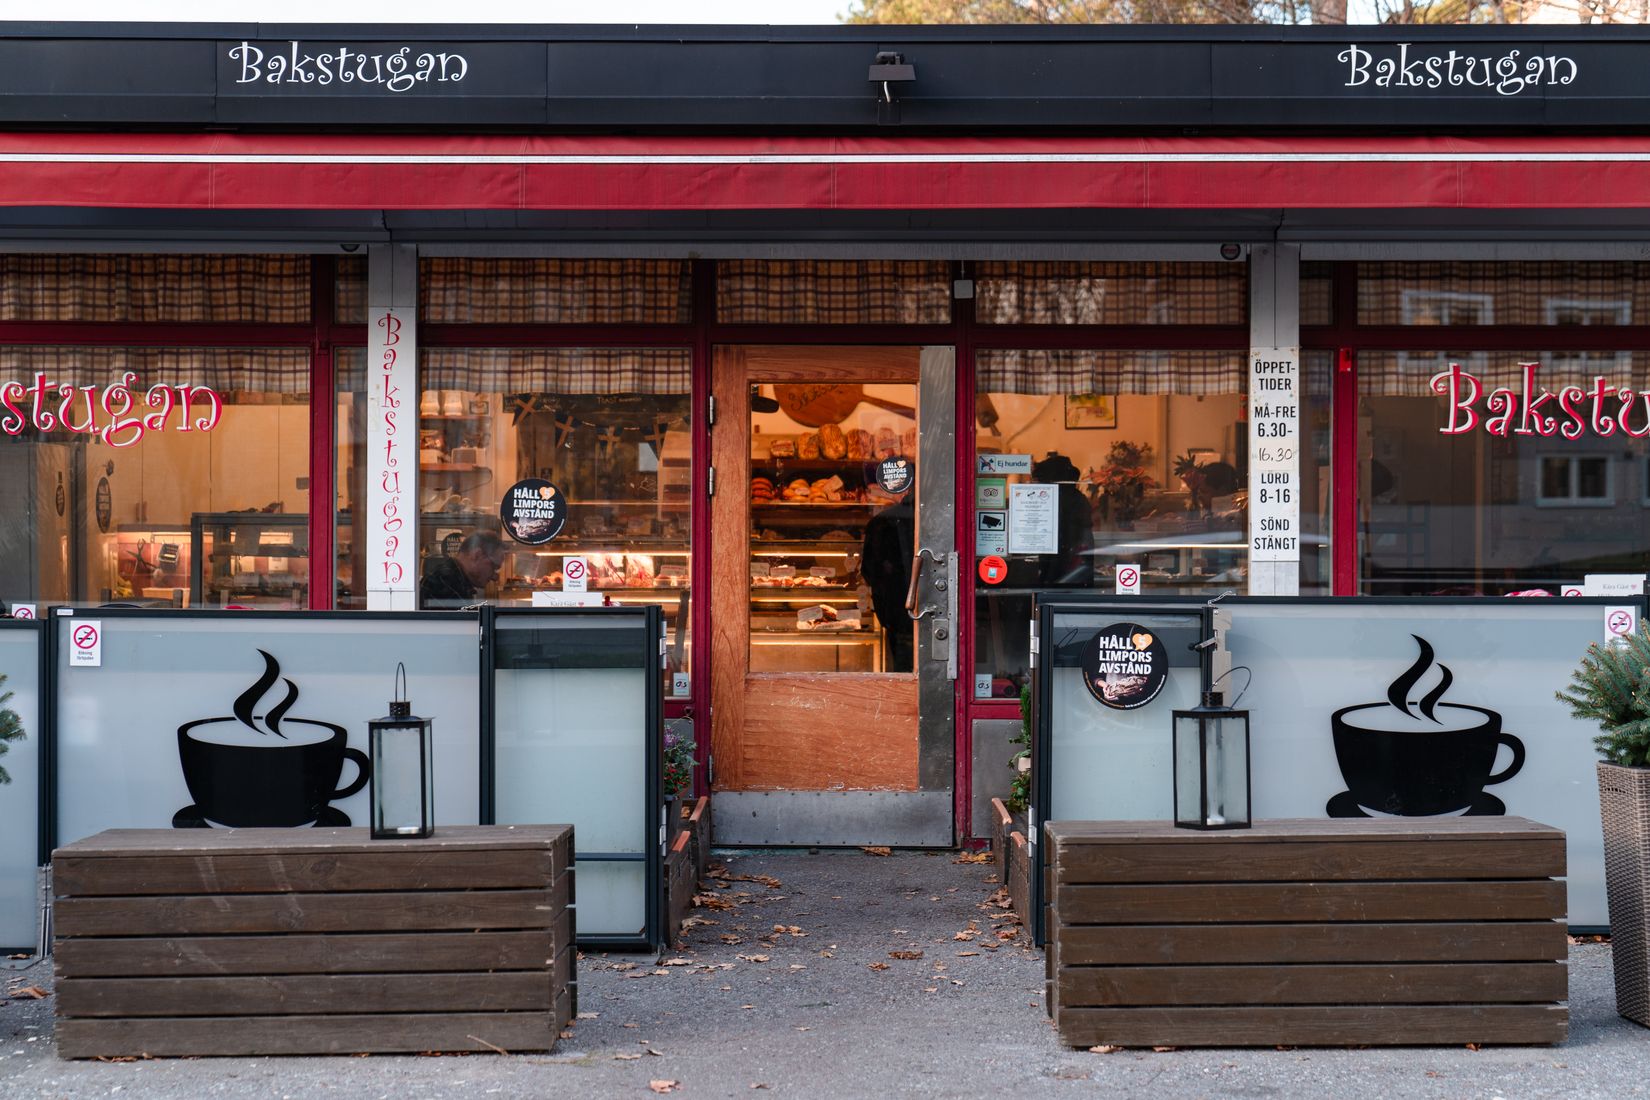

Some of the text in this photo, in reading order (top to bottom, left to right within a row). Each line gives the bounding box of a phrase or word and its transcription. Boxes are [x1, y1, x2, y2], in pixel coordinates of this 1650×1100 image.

[228, 40, 468, 92] Bakstugan
[1337, 43, 1578, 95] Bakstugan
[1255, 359, 1295, 374] ÖPPET-
[1259, 378, 1292, 390] TIDER
[1254, 403, 1296, 418] MÅ-FRE
[1258, 422, 1293, 437] 6.30-
[378, 312, 403, 584] Bakstugan
[1259, 447, 1293, 462] 16.30
[997, 460, 1004, 468] Ej
[513, 487, 540, 499] HÅLL
[1260, 489, 1290, 503] 8-16
[513, 499, 555, 510] LIMPORS
[513, 508, 554, 519] AVSTÅND
[1260, 516, 1290, 531] SÖND
[1254, 534, 1297, 550] STÄNGT
[1100, 634, 1133, 650] HÅLL
[1099, 650, 1152, 663] LIMPORS
[1099, 661, 1152, 675] AVSTÅND
